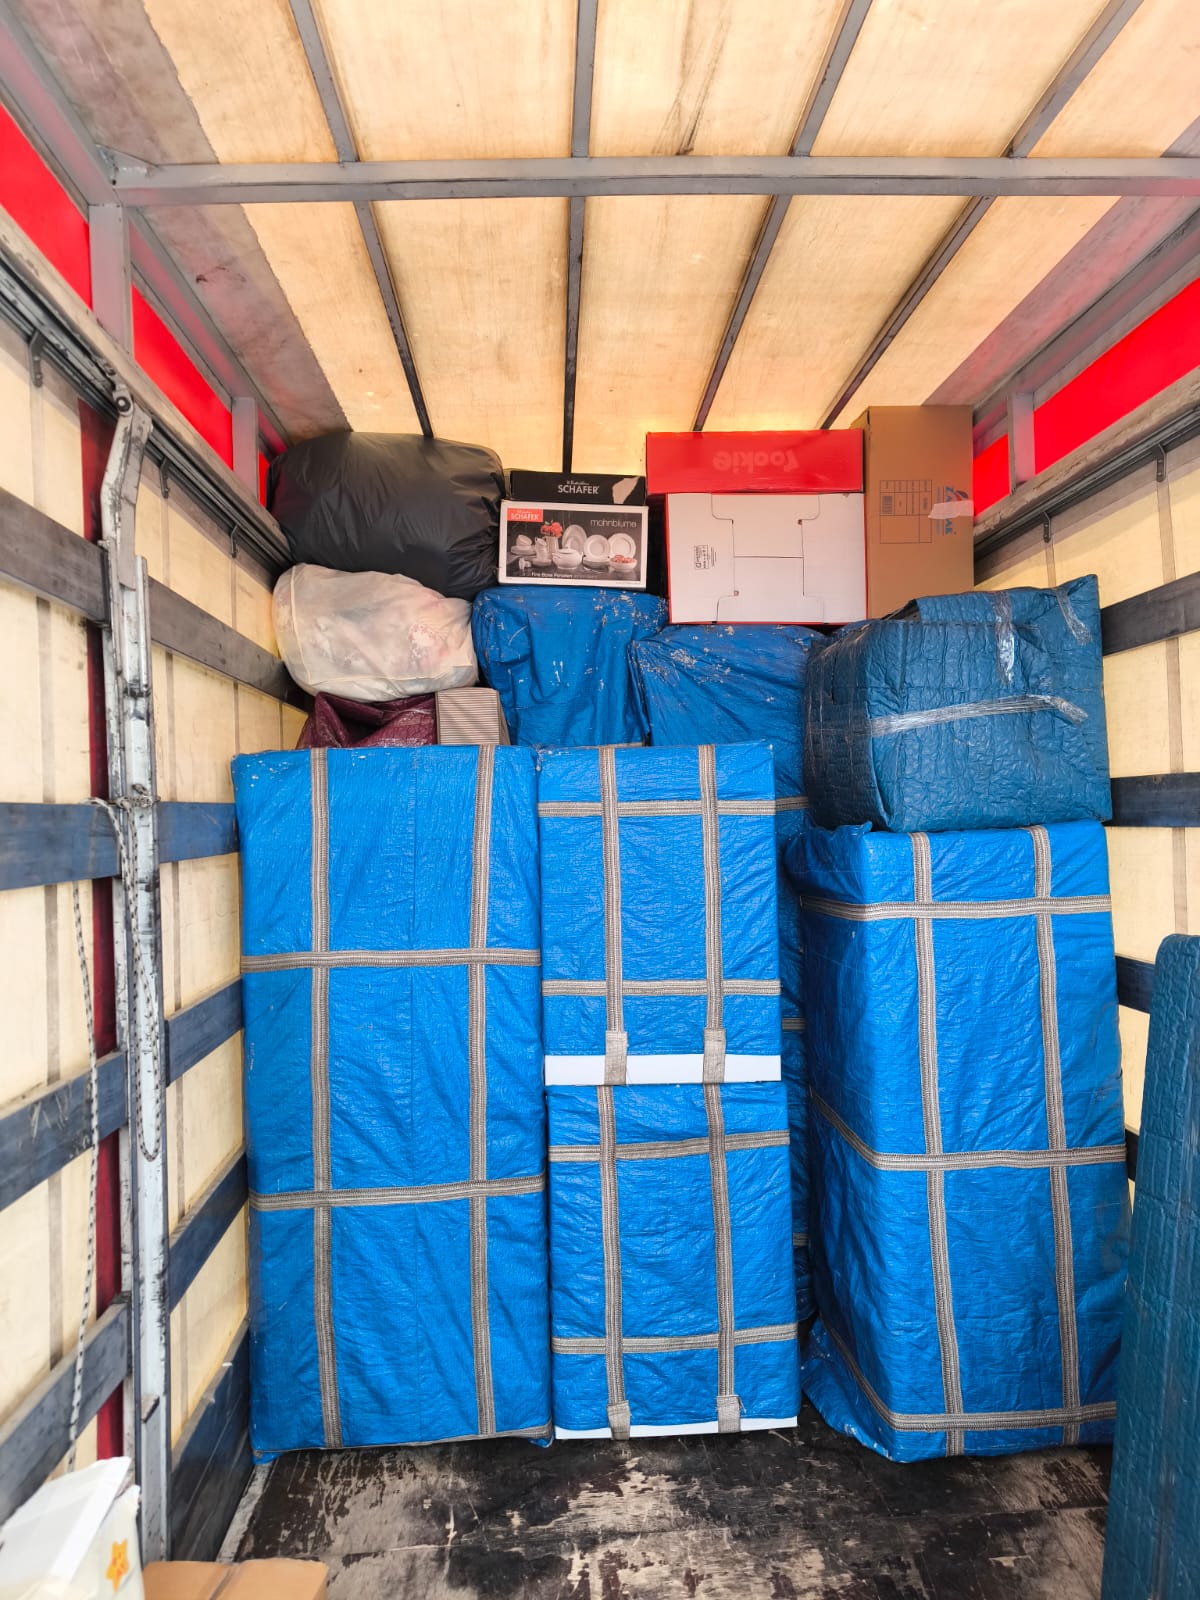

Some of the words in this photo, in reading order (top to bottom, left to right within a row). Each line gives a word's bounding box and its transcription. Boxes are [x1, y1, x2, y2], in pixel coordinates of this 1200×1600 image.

[712, 449, 799, 473] rookie
[558, 484, 598, 495] SCHAFER
[590, 519, 637, 528] mohnblume
